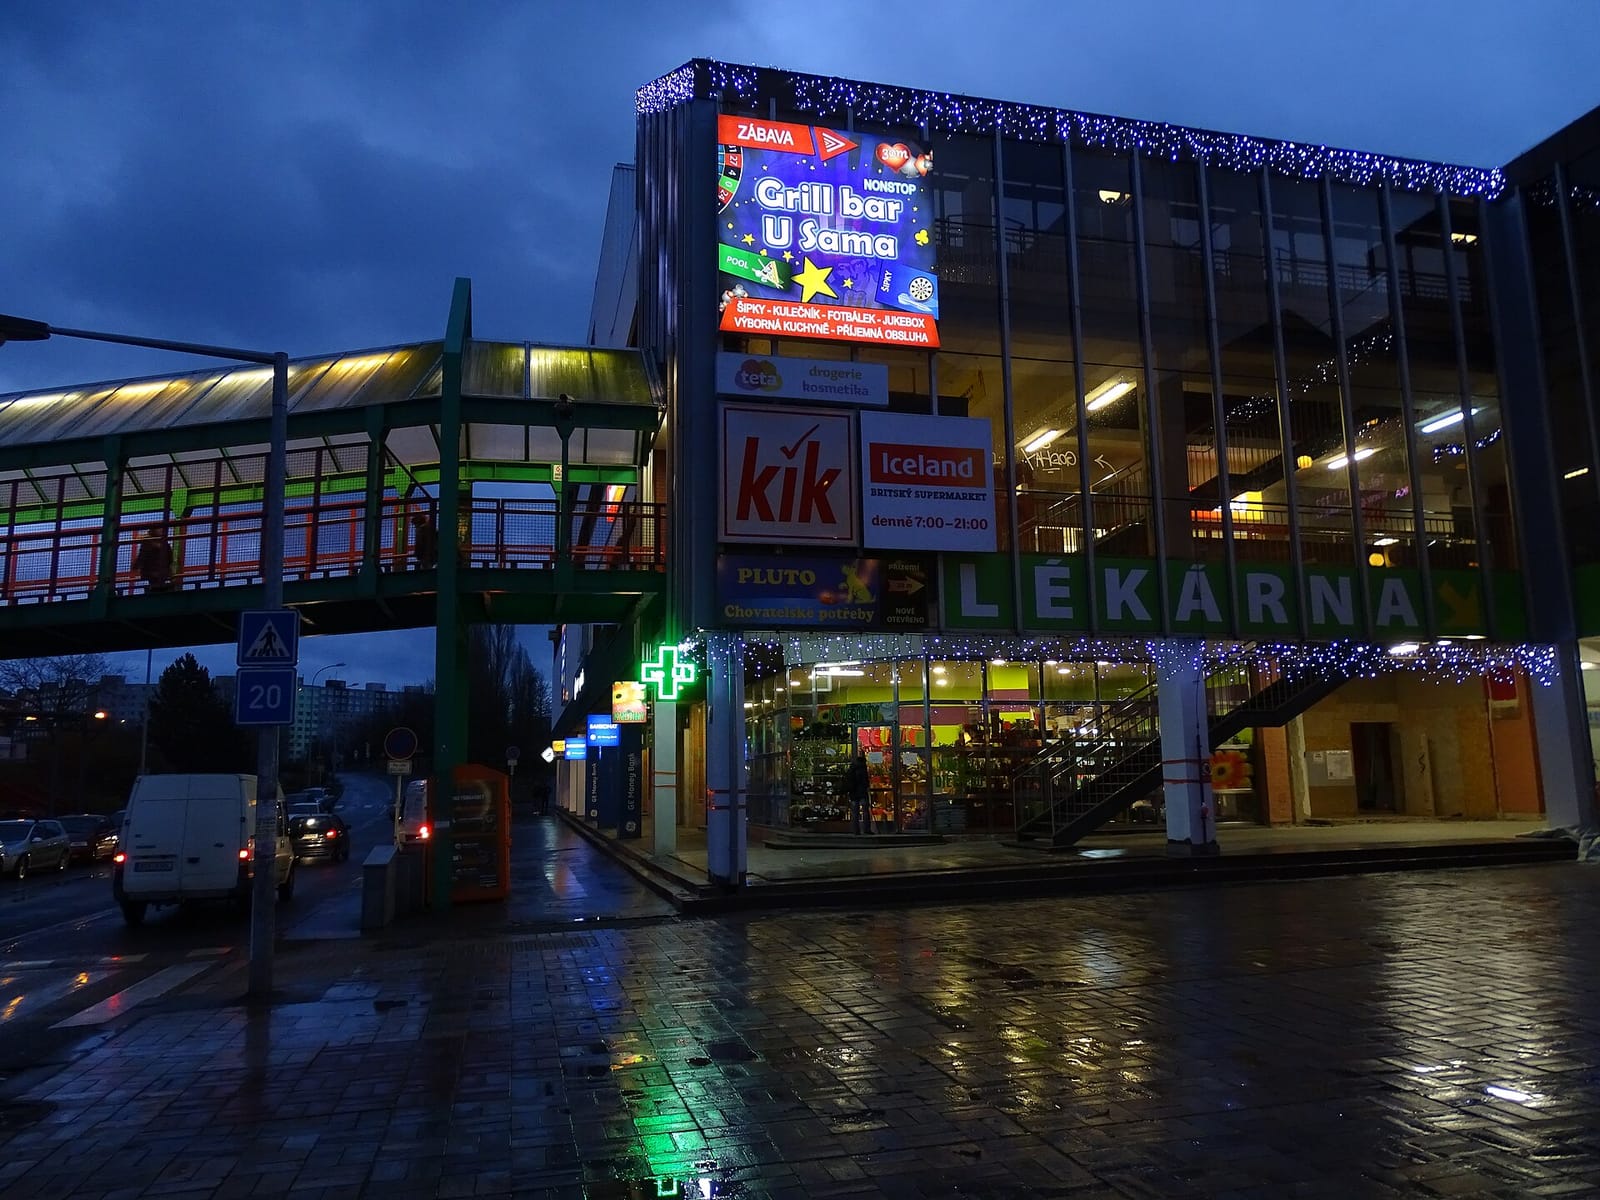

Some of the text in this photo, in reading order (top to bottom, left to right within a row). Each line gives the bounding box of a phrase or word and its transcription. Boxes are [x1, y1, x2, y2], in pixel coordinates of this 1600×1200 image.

[738, 123, 794, 145] ZÁBAVA
[863, 178, 917, 195] NONSTOP
[756, 177, 903, 223] Grill bar
[763, 216, 899, 259] U Sama
[726, 255, 750, 269] POOL
[881, 270, 893, 292] ŠIPKY
[737, 300, 766, 314] ŠIPKY
[773, 306, 820, 319] KULEČNÍK
[828, 310, 876, 324] FOTBÁLEK
[882, 315, 925, 328] JUKEBOX
[734, 316, 782, 331] VÝBORNÁ
[783, 321, 830, 334] KUCHYNĚ
[837, 325, 883, 339] PŘÍJEMNÁ
[885, 329, 929, 342] OBSLUHA
[739, 365, 777, 386] teta
[809, 366, 863, 381] drogerie
[802, 381, 870, 396] kosmetika
[736, 424, 842, 525] kik
[881, 452, 973, 479] Iceland
[870, 487, 987, 501] BRITSKÝ SUPERMARKET
[871, 515, 913, 528] denně
[737, 567, 817, 585] PLUTO
[959, 557, 1419, 629] LÉKÁRNA
[724, 604, 875, 622] Chovatelské potřeby
[249, 684, 282, 710] 20
[627, 752, 636, 772] Bank
[627, 773, 637, 798] Money
